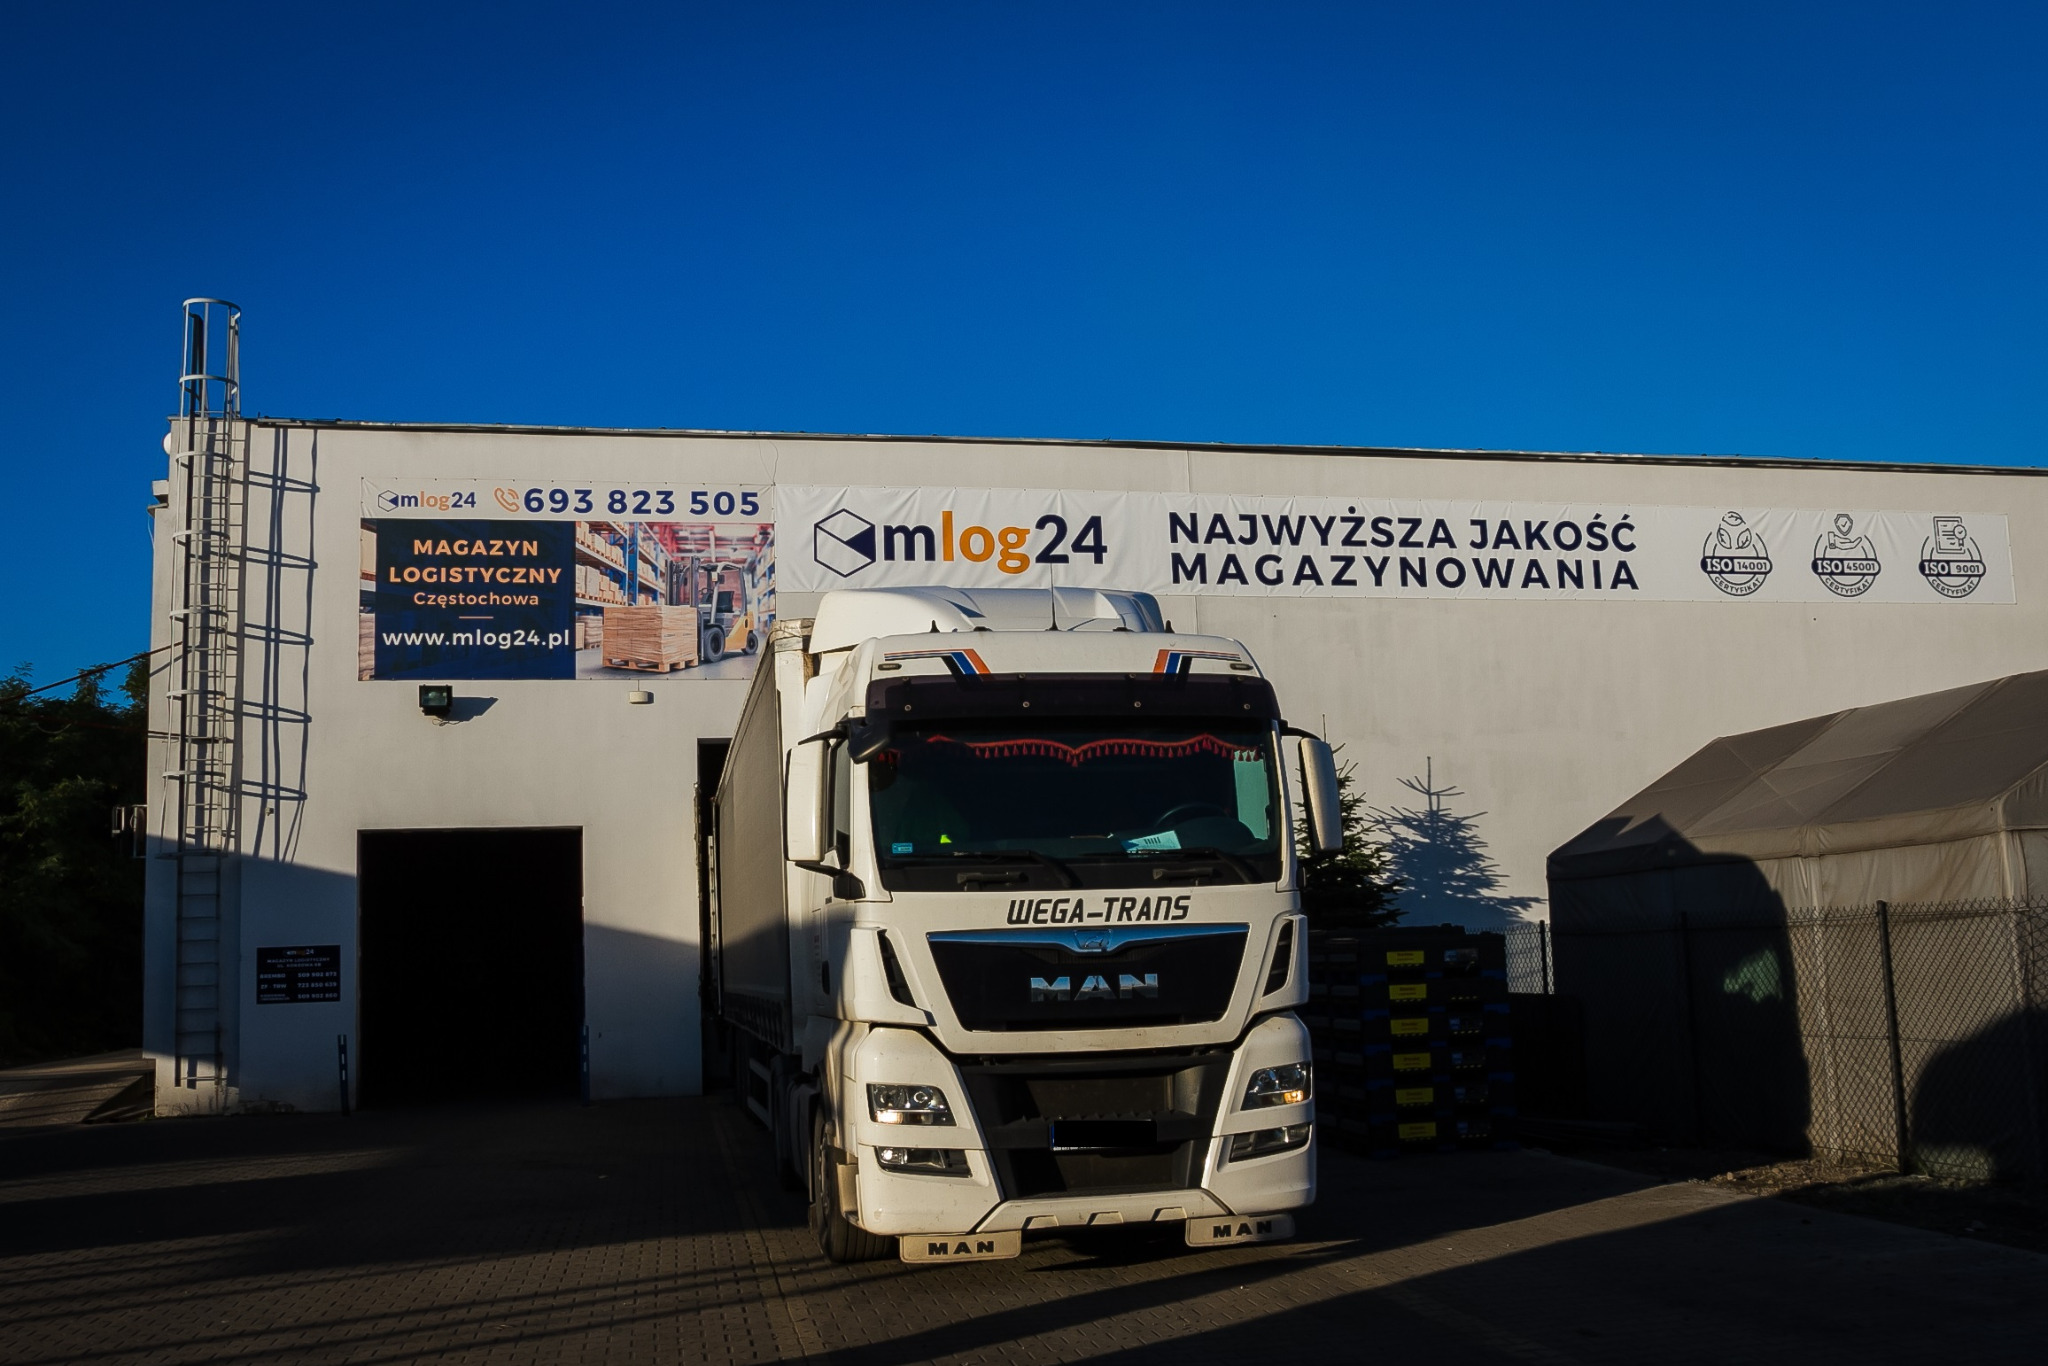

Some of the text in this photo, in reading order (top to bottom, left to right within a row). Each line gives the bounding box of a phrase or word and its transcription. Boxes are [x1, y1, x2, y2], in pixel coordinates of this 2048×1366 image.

[401, 490, 476, 511] mlog24
[523, 488, 760, 516] 693 823 505
[1168, 506, 1637, 553] NAJWYŻSZA JAKOŚĆ
[413, 539, 538, 556] MAGAZYN
[883, 510, 1108, 574] mlog24
[1171, 552, 1639, 590] MAGAZYNOWANIA
[1705, 558, 1767, 572] ISO 14001
[1816, 560, 1876, 573] ISO 45001
[1923, 561, 1980, 574] ISO 9001
[389, 566, 562, 584] LOGISTYCZNY
[1714, 576, 1761, 593] CERTYFIKAT
[1825, 577, 1870, 594] CERTYFIKAT
[1931, 578, 1975, 595] CERTYFIKAT
[413, 592, 539, 609] Częstochowa
[382, 629, 570, 650] www.mlog24.pl
[1006, 895, 1191, 926] WEGA-TRANS
[1030, 973, 1158, 1002] MAN
[1213, 1219, 1273, 1239] MAN
[927, 1240, 995, 1256] MAN
